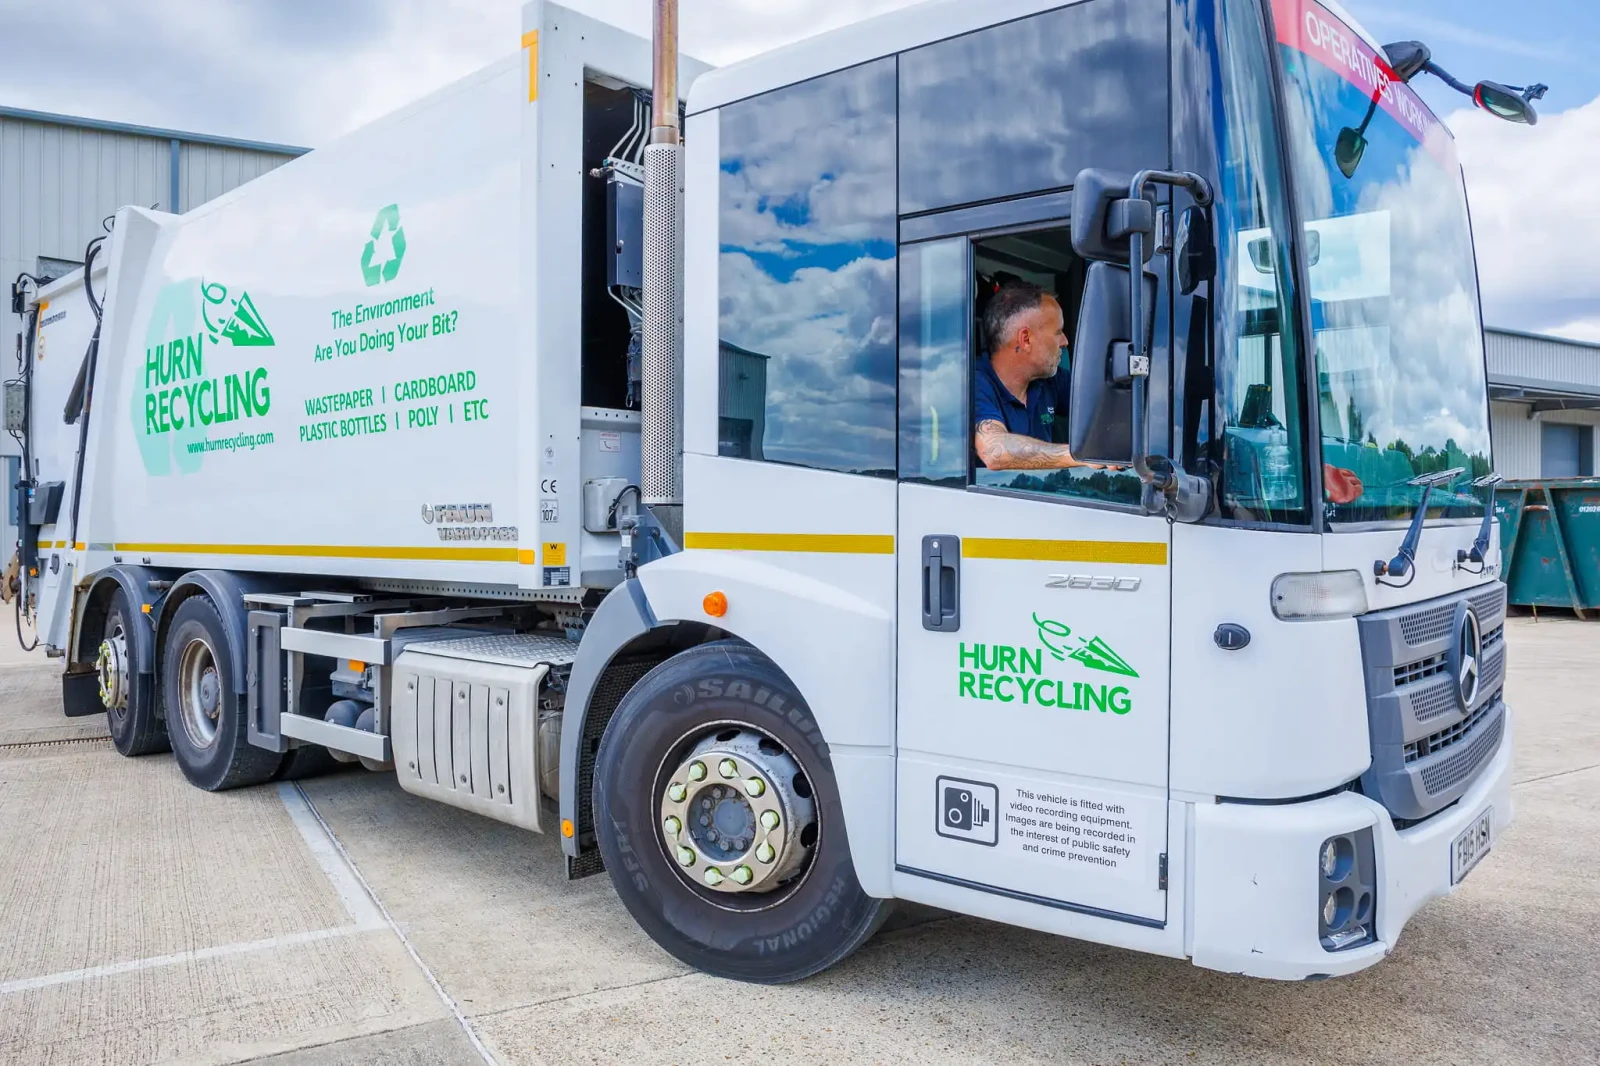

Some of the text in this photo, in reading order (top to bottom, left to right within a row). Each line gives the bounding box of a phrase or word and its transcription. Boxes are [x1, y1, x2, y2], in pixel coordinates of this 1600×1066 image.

[1305, 11, 1394, 104] OPERATIVES
[331, 310, 353, 330] The
[314, 310, 458, 363] Are You Doing Your Bit?
[145, 332, 203, 389] HURN
[145, 367, 271, 435] RECYCLING
[305, 388, 374, 416] WASTEPAPER
[394, 370, 476, 402] CARDBOARD
[300, 420, 338, 442] PLASTIC
[341, 413, 387, 437] BOTTLES
[408, 406, 439, 428] POLY
[464, 399, 489, 421] ETC
[187, 431, 275, 454] www.hurnrecycling.com
[541, 479, 557, 493] CE
[434, 503, 493, 522] FAUN
[542, 509, 553, 521] 107
[1045, 573, 1142, 592] 2630
[959, 642, 1043, 675] HURN
[959, 671, 1132, 715] RECYCLING
[1010, 802, 1132, 829] video recording equipment.
[1016, 788, 1125, 814] This vehicle is fitted with
[1005, 813, 1136, 843] Images are being recorded in
[1010, 828, 1131, 858] the interest of public safety
[1022, 843, 1117, 867] and crime prevention
[753, 876, 845, 954] REGIONAL
